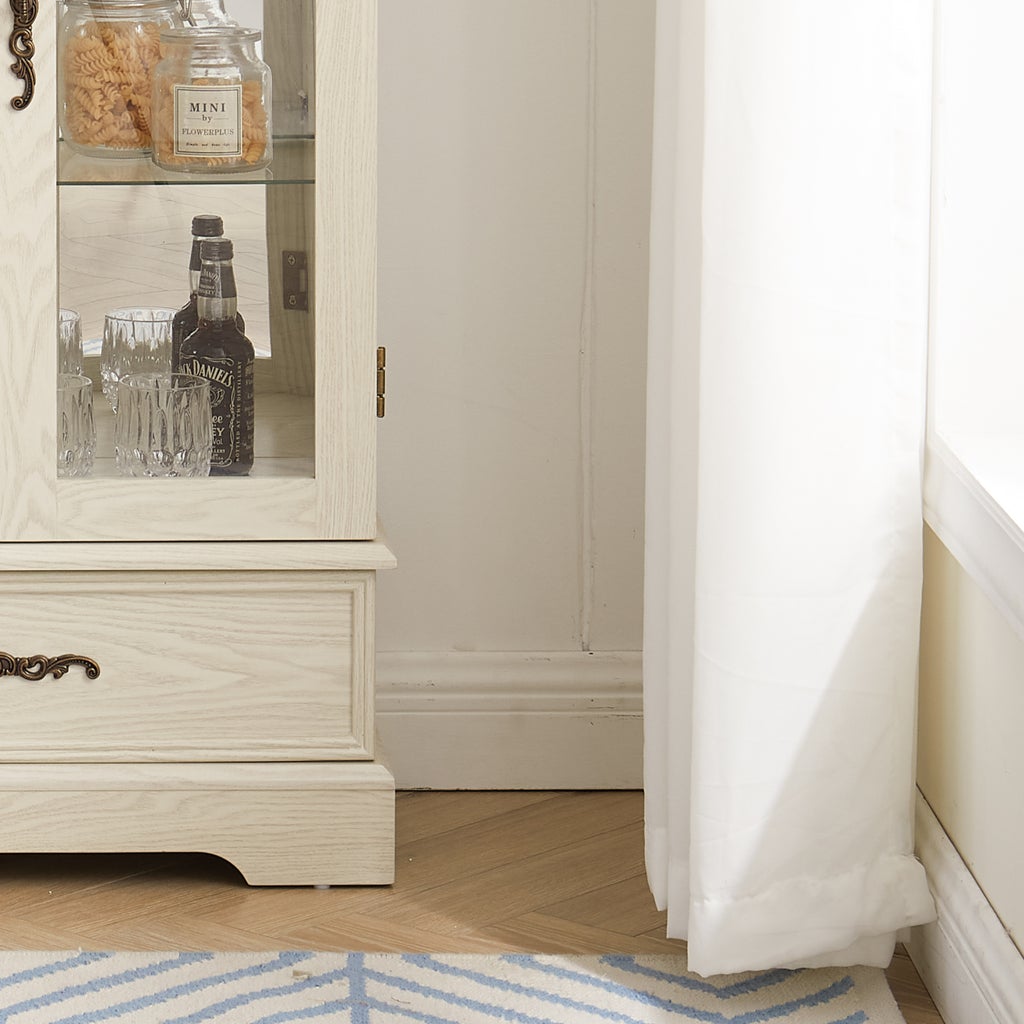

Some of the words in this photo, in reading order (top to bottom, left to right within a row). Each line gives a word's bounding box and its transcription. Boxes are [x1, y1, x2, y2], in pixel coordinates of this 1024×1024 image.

[189, 102, 226, 113] MINI
[202, 114, 213, 123] by
[182, 128, 235, 136] FLOWERPLUS
